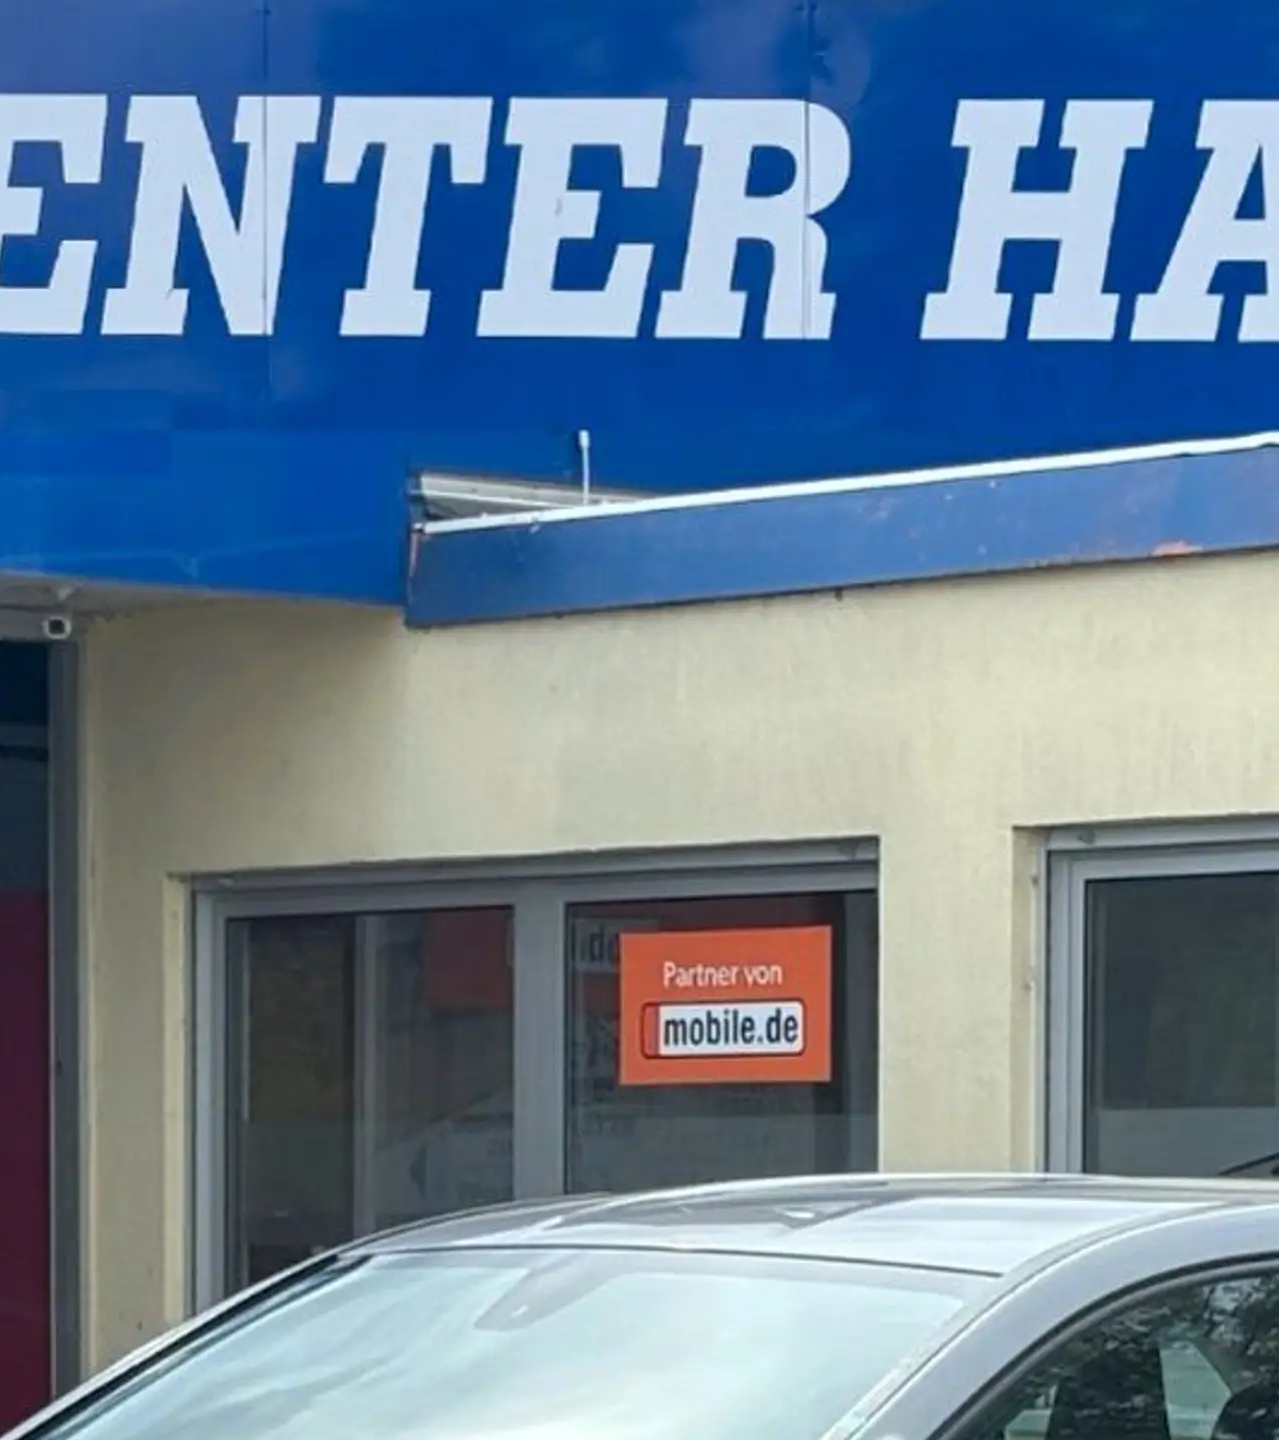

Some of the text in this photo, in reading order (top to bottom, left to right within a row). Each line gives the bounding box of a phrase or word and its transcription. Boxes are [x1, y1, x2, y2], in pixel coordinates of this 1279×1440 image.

[663, 961, 783, 988] Partner von
[663, 1009, 799, 1046] mobile.de
